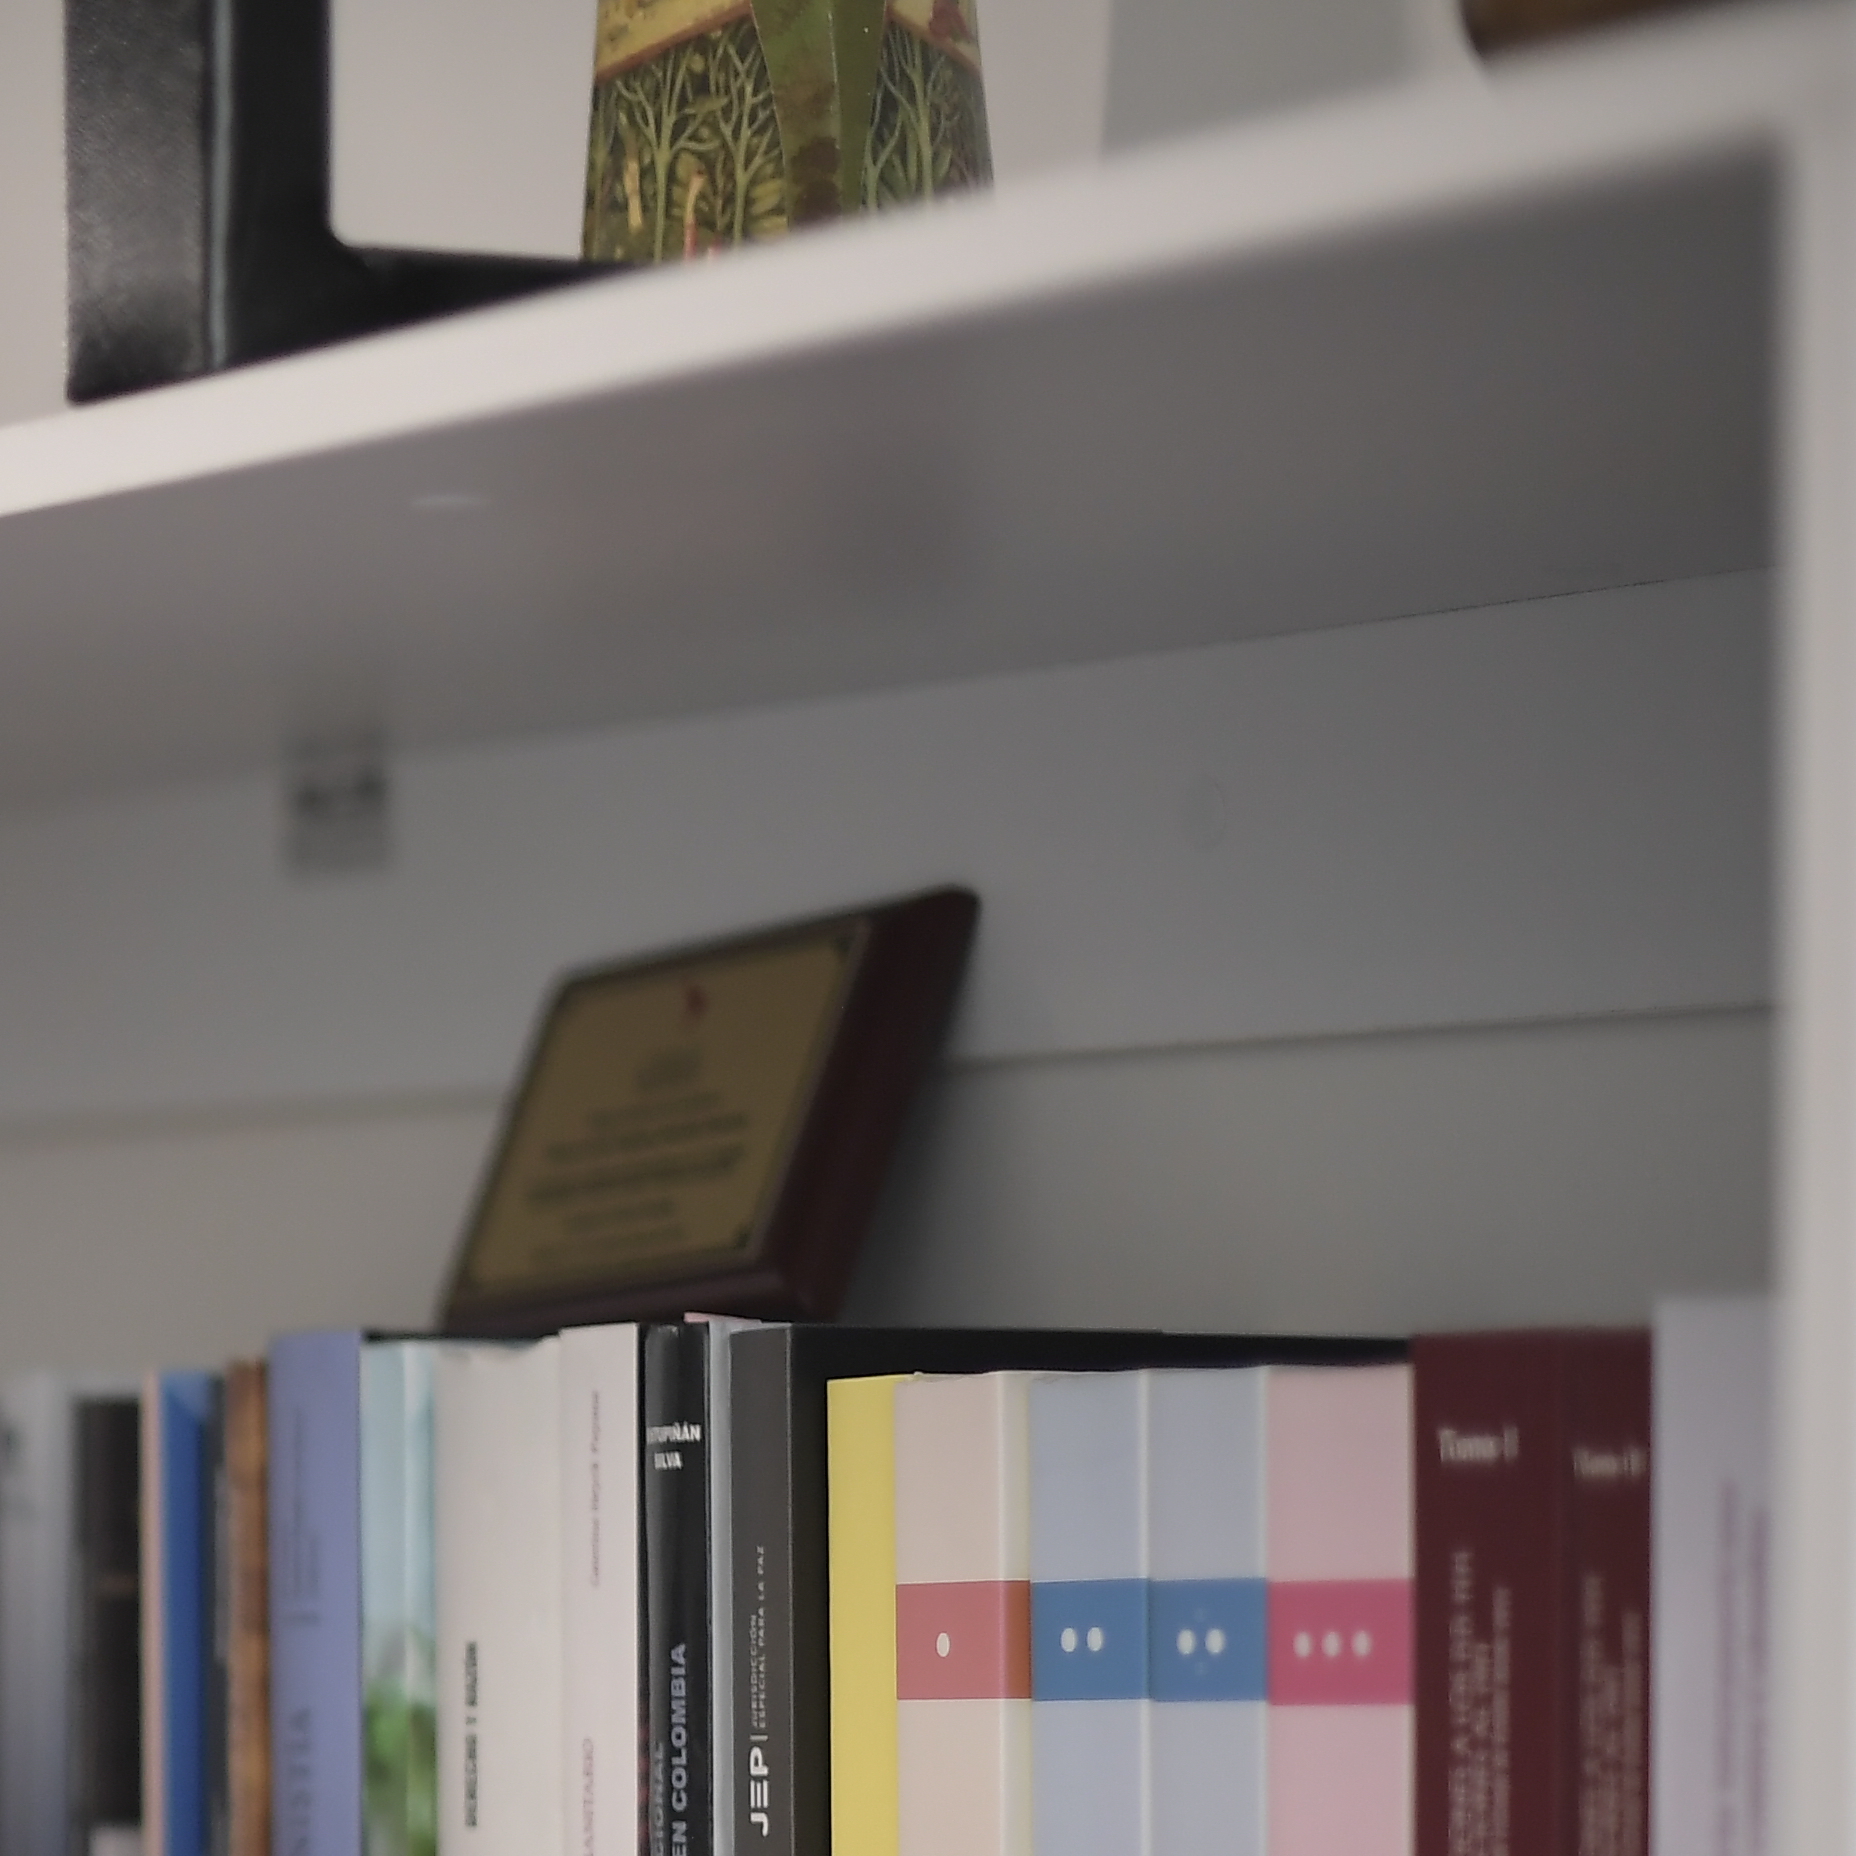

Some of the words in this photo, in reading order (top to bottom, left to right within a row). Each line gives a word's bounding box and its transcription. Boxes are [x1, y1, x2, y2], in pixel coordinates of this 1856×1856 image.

[756, 1545, 765, 1575] PAZ
[757, 1581, 765, 1601] LA
[757, 1606, 766, 1647] PARA
[671, 1643, 688, 1812] COLOMBIA
[749, 1745, 769, 1837] JEP
